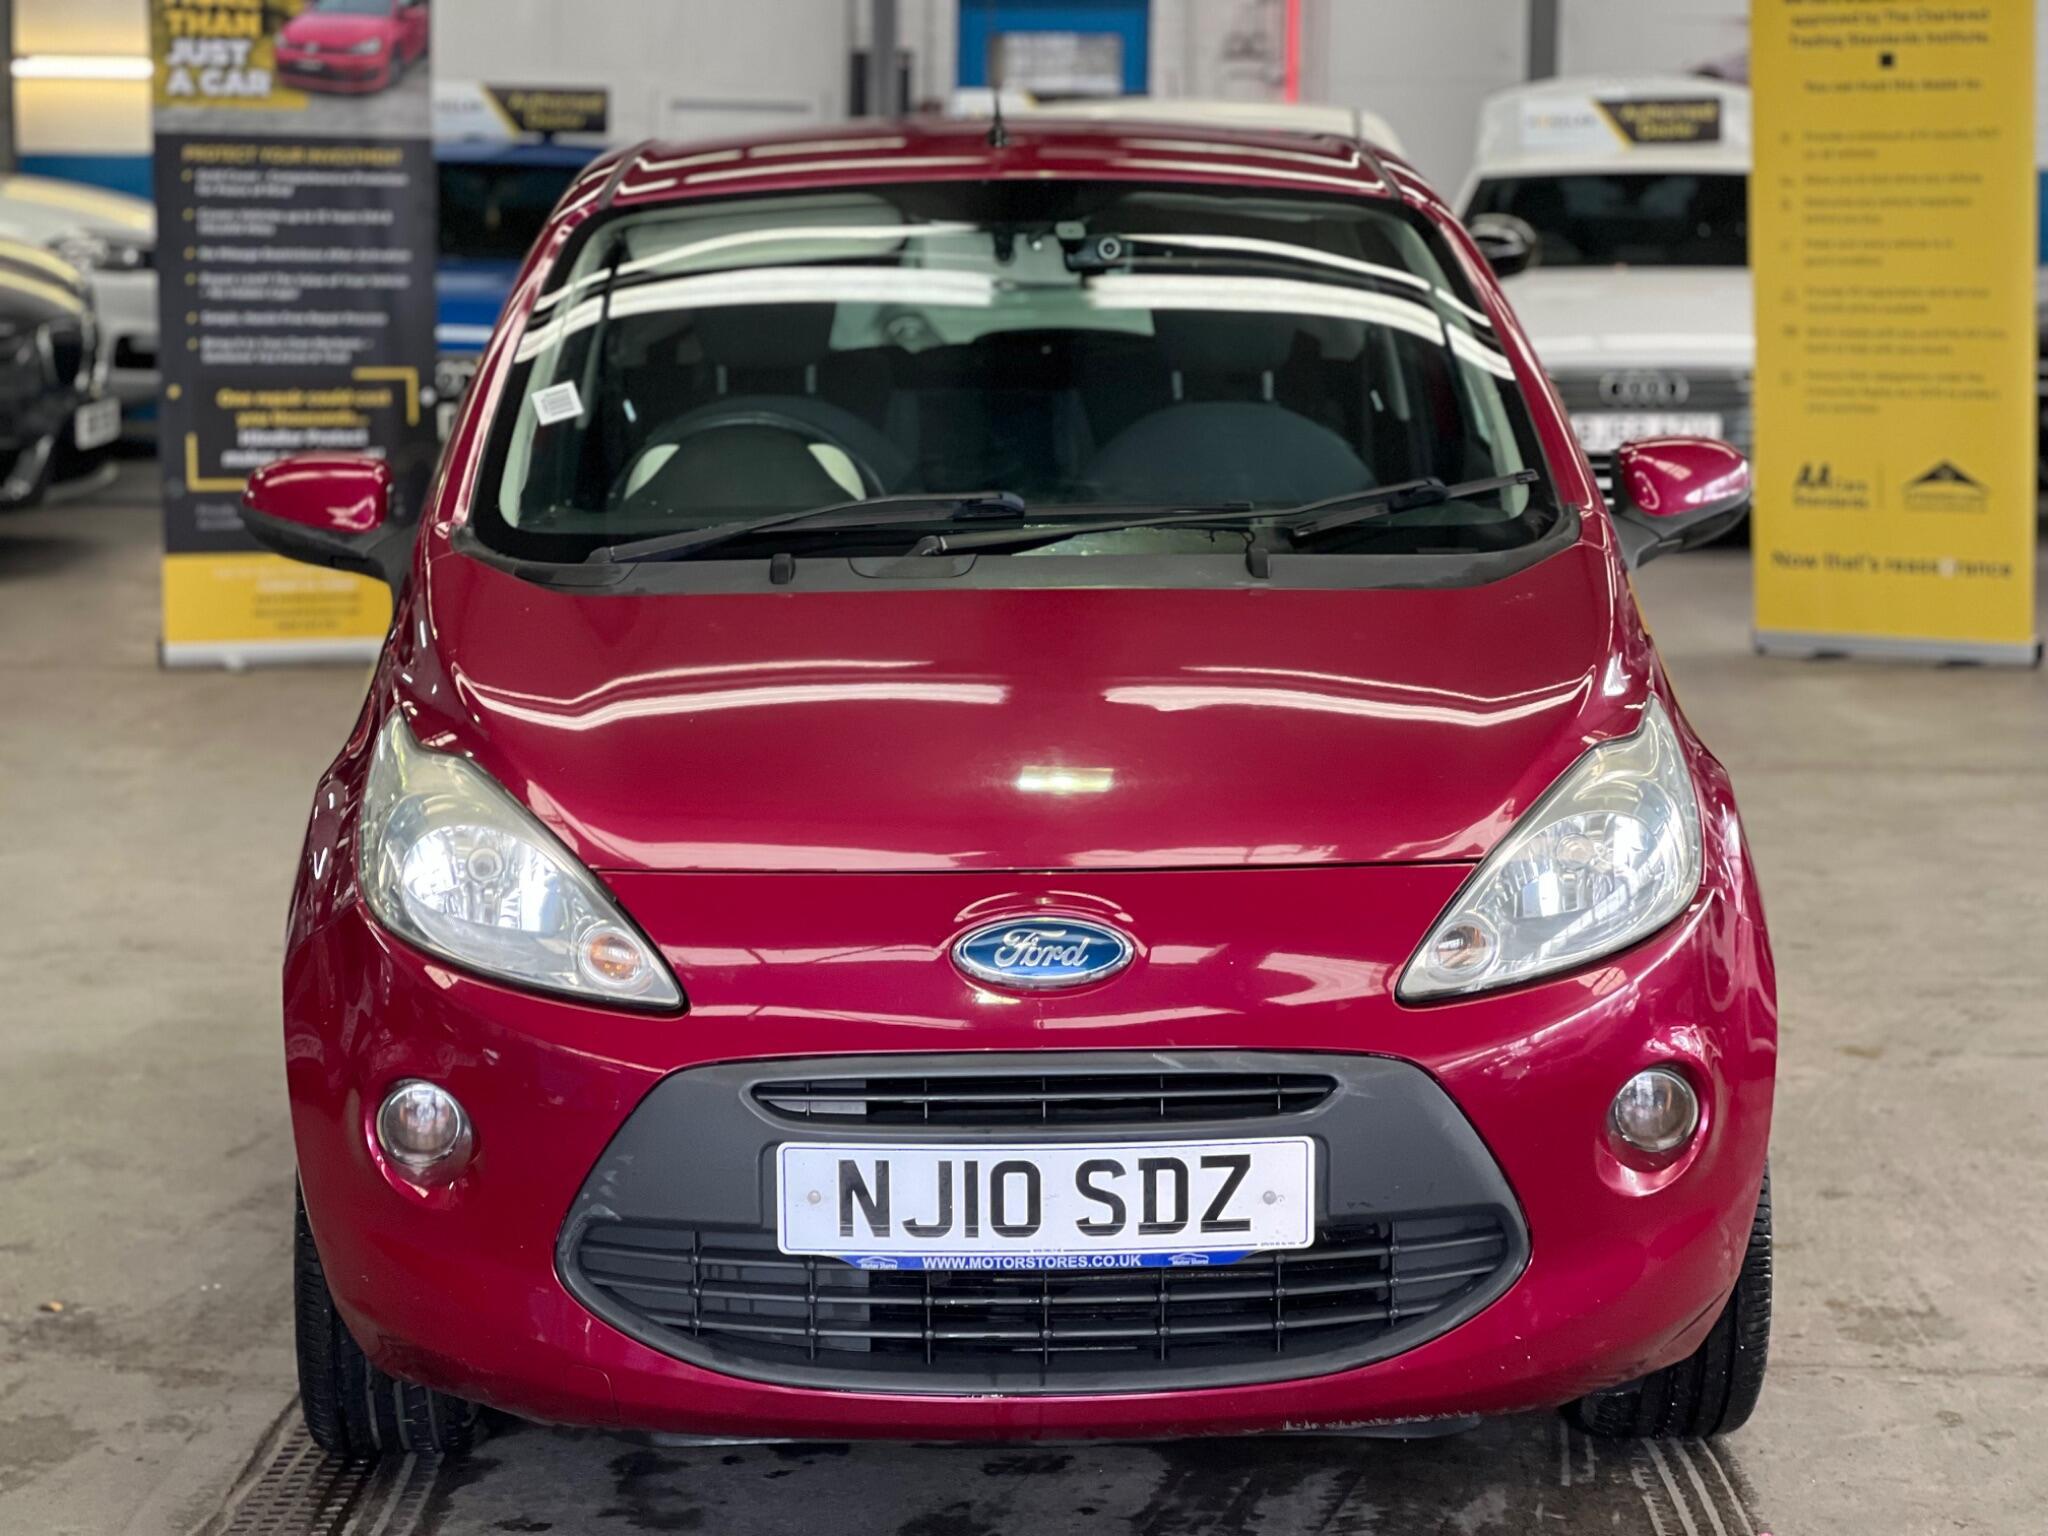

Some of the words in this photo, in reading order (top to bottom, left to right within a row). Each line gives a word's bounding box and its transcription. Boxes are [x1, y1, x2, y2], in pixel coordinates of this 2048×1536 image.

[167, 9, 260, 37] THAN
[166, 37, 252, 65] JUST
[166, 67, 195, 97] A
[200, 67, 272, 98] CAR
[994, 929, 1091, 967] Ford
[838, 1159, 1042, 1238] NJ10
[1075, 1154, 1252, 1237] SDZ
[922, 1254, 1142, 1269] WWW.MOTORSTORES.CO.UK
